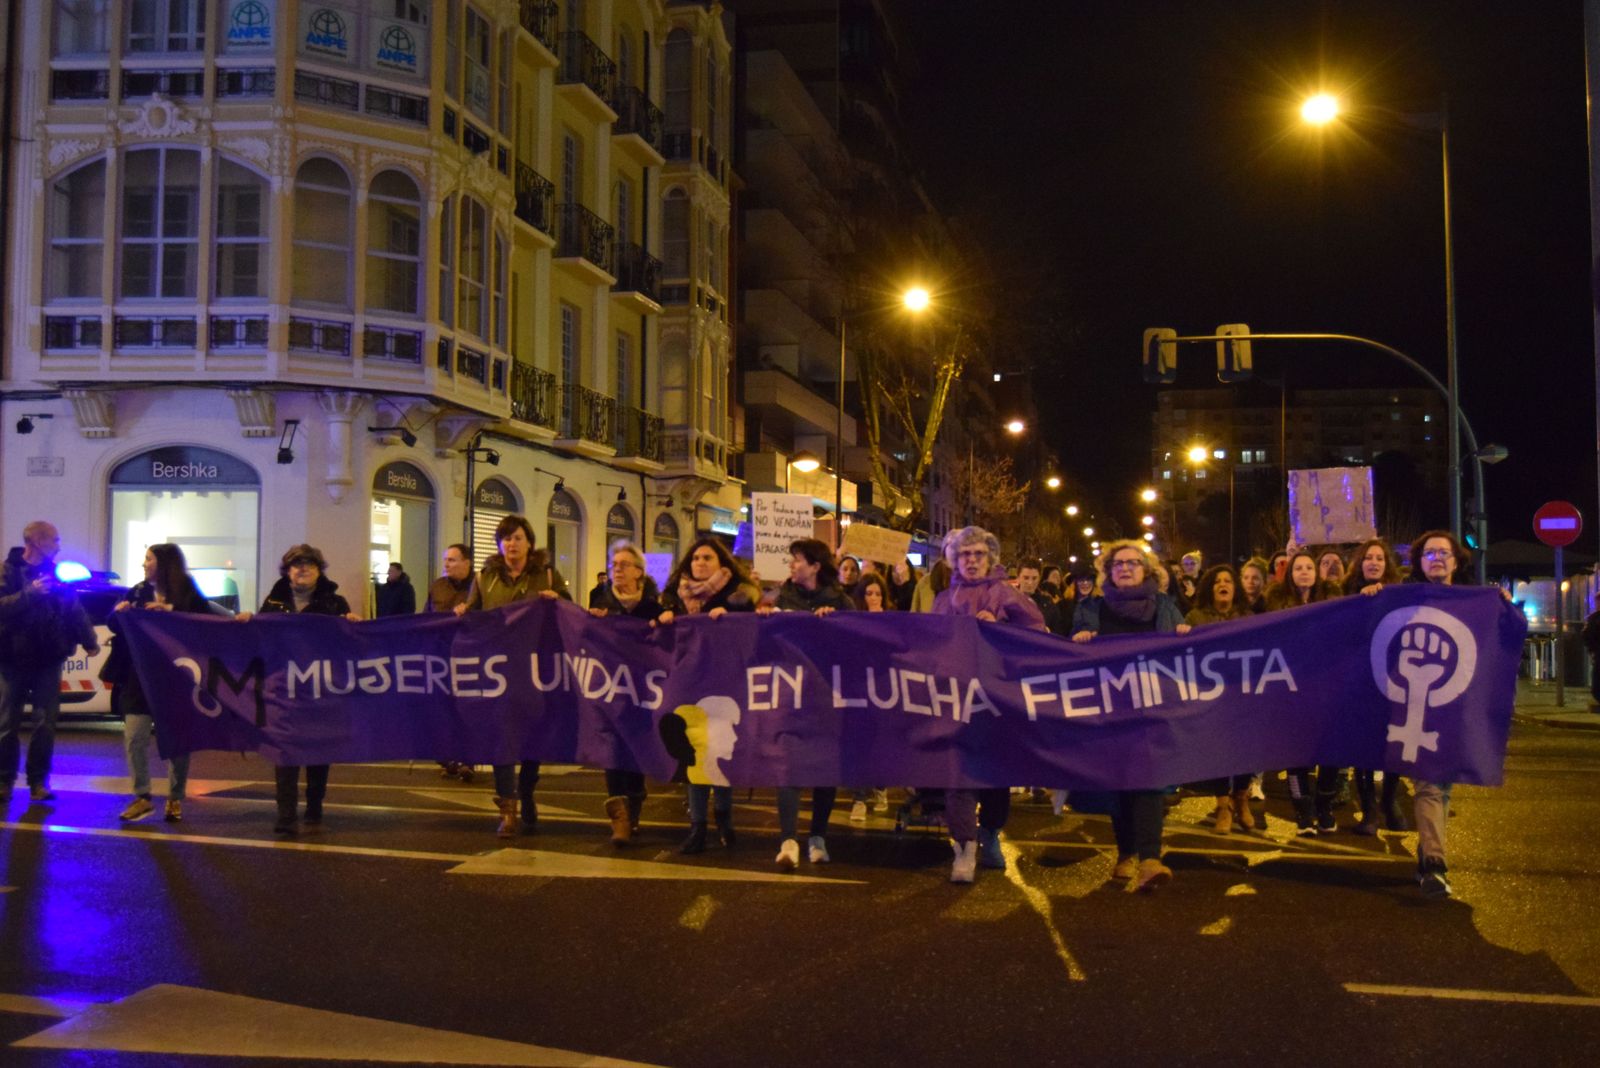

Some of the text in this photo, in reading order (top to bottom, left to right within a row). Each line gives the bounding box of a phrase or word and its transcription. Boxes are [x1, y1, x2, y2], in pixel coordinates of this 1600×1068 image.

[227, 26, 271, 39] ANPE
[305, 31, 348, 50] ANPE
[377, 48, 416, 66] ANPE
[152, 461, 218, 478] Bershka
[387, 470, 417, 490] Bershka
[480, 488, 504, 505] Bershka
[755, 515, 768, 527] NO
[287, 654, 508, 700] MUJERES
[746, 665, 803, 711] EN
[832, 664, 1001, 724] LUCHA
